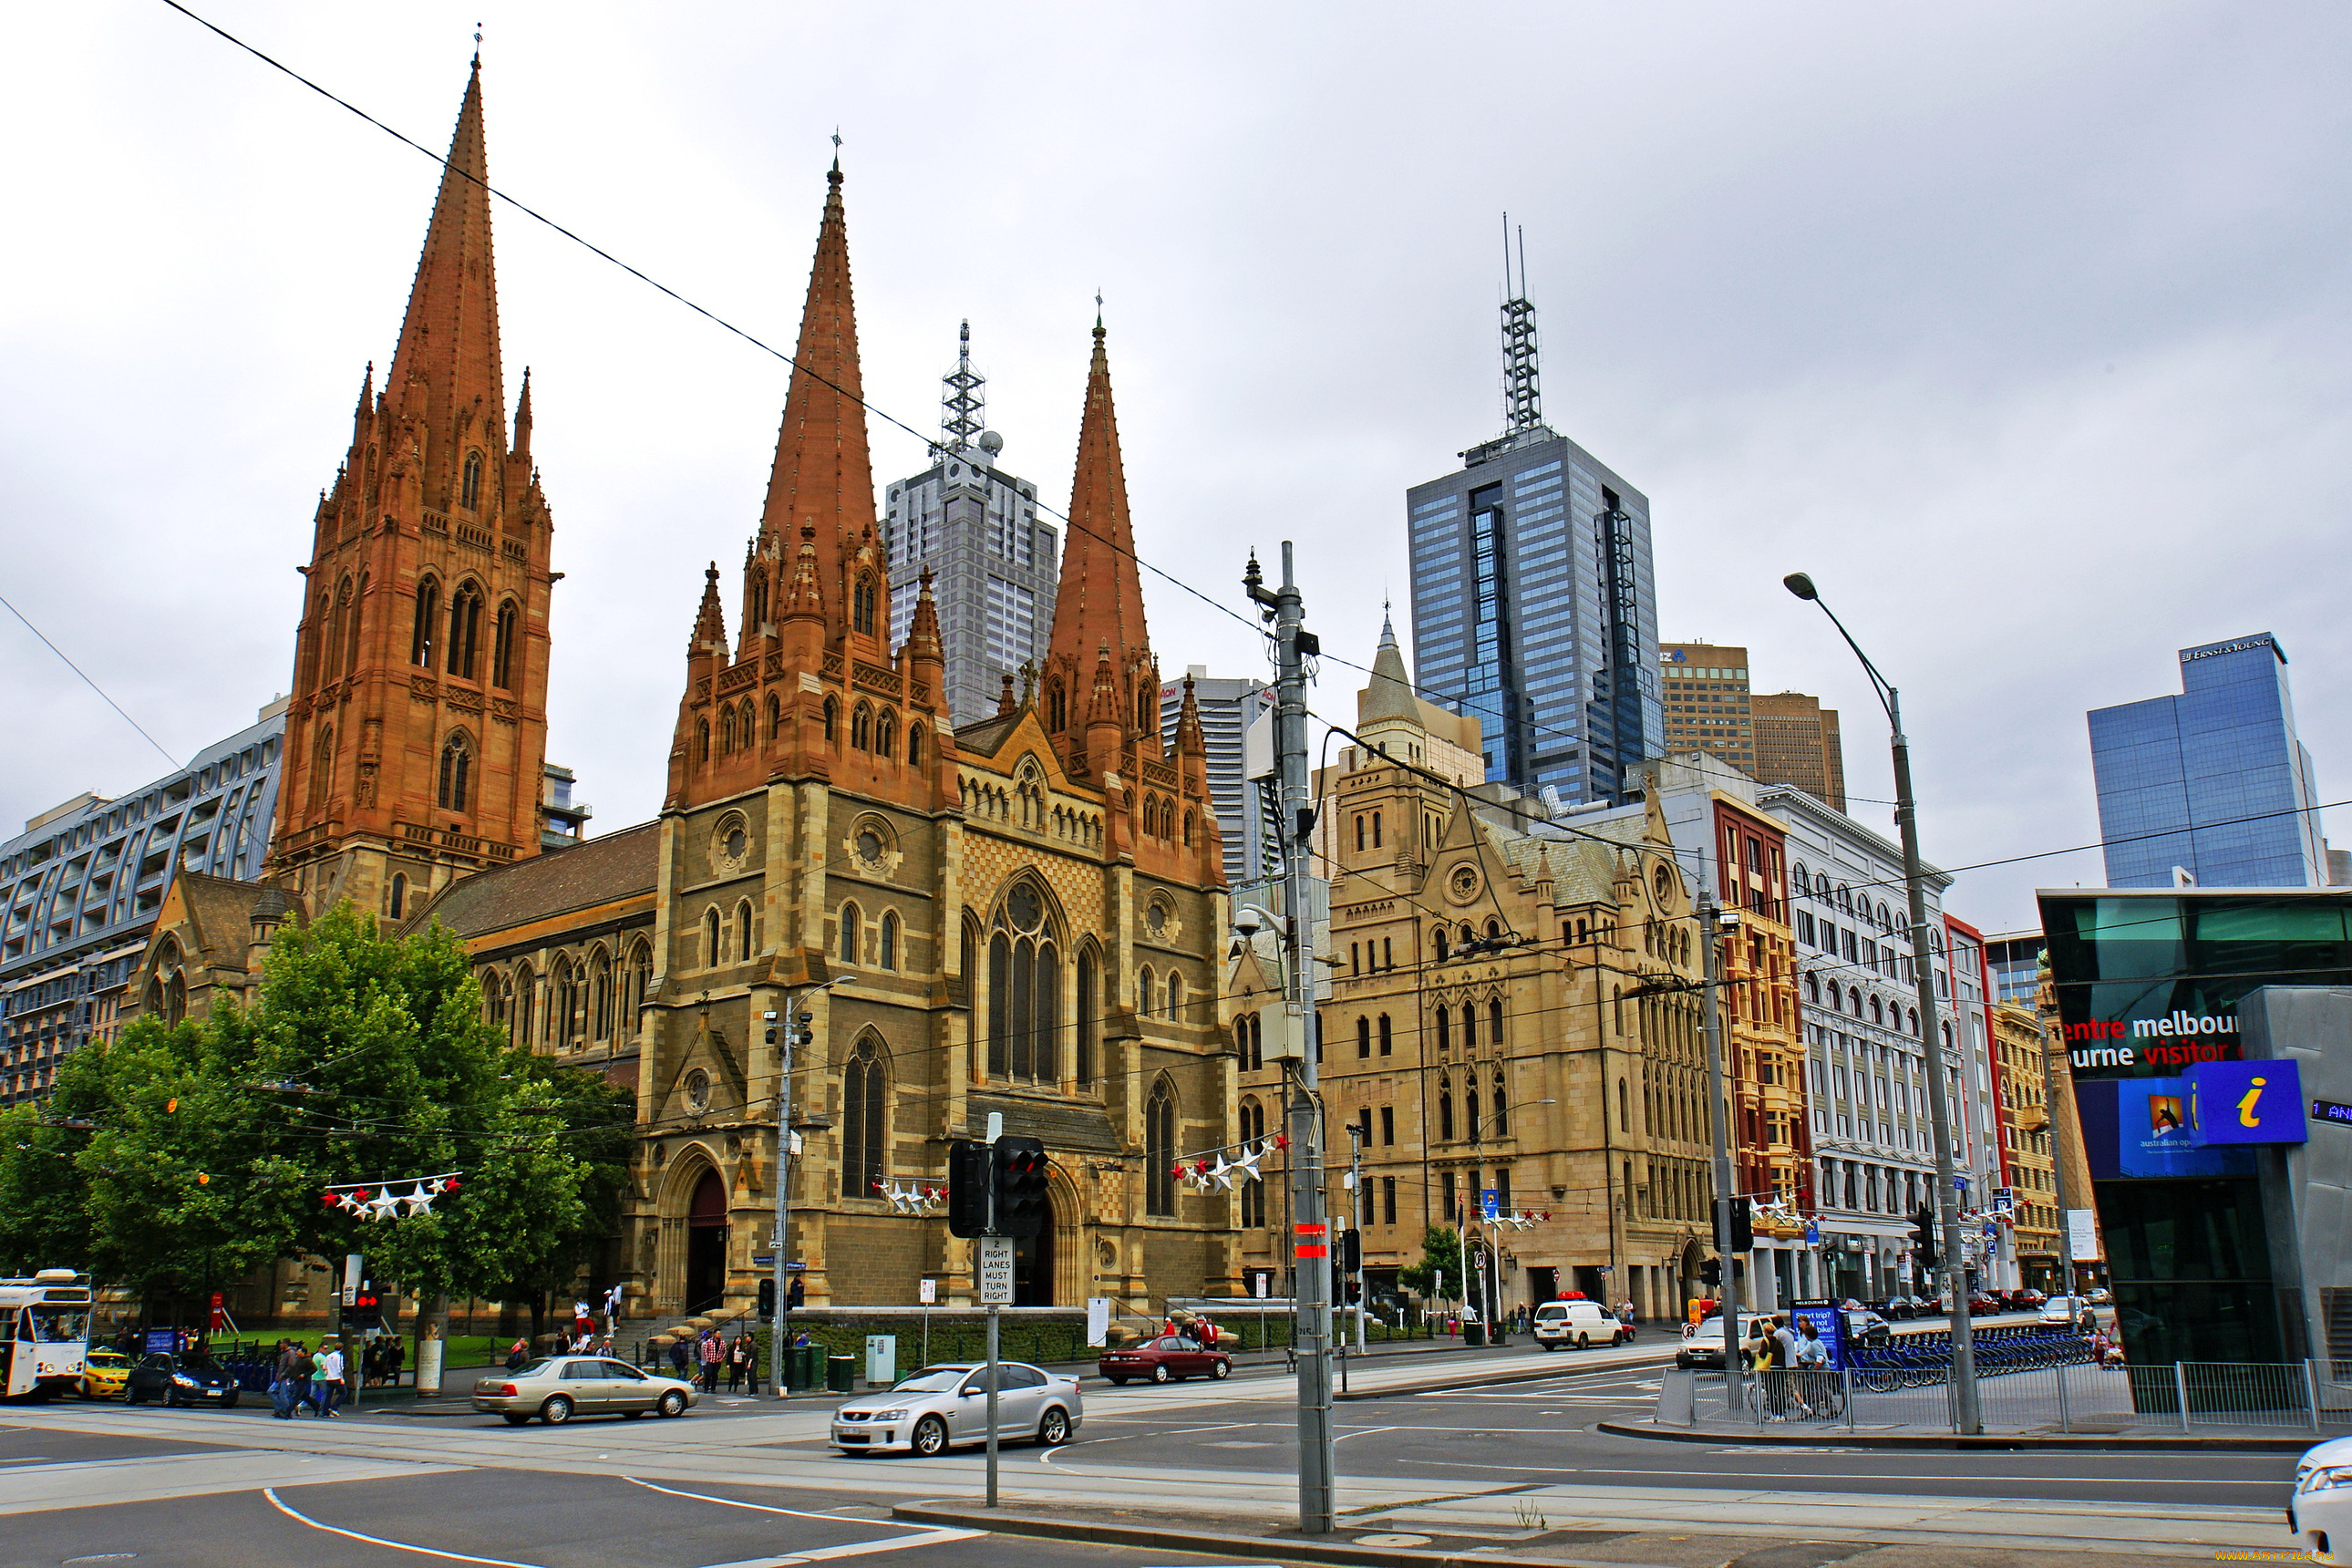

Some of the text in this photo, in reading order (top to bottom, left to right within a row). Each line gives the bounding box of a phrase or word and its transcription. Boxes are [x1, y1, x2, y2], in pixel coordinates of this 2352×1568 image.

[2143, 1038, 2229, 1066] visitor
[2140, 1138, 2179, 1148] australian
[994, 1240, 1000, 1248] 2
[985, 1250, 1008, 1258] RIGHT
[983, 1261, 1011, 1269] LANES
[985, 1272, 1007, 1280] MUST
[985, 1282, 1007, 1290] TURN
[984, 1292, 1008, 1300] RIGHT
[1815, 1311, 1831, 1320] trip?
